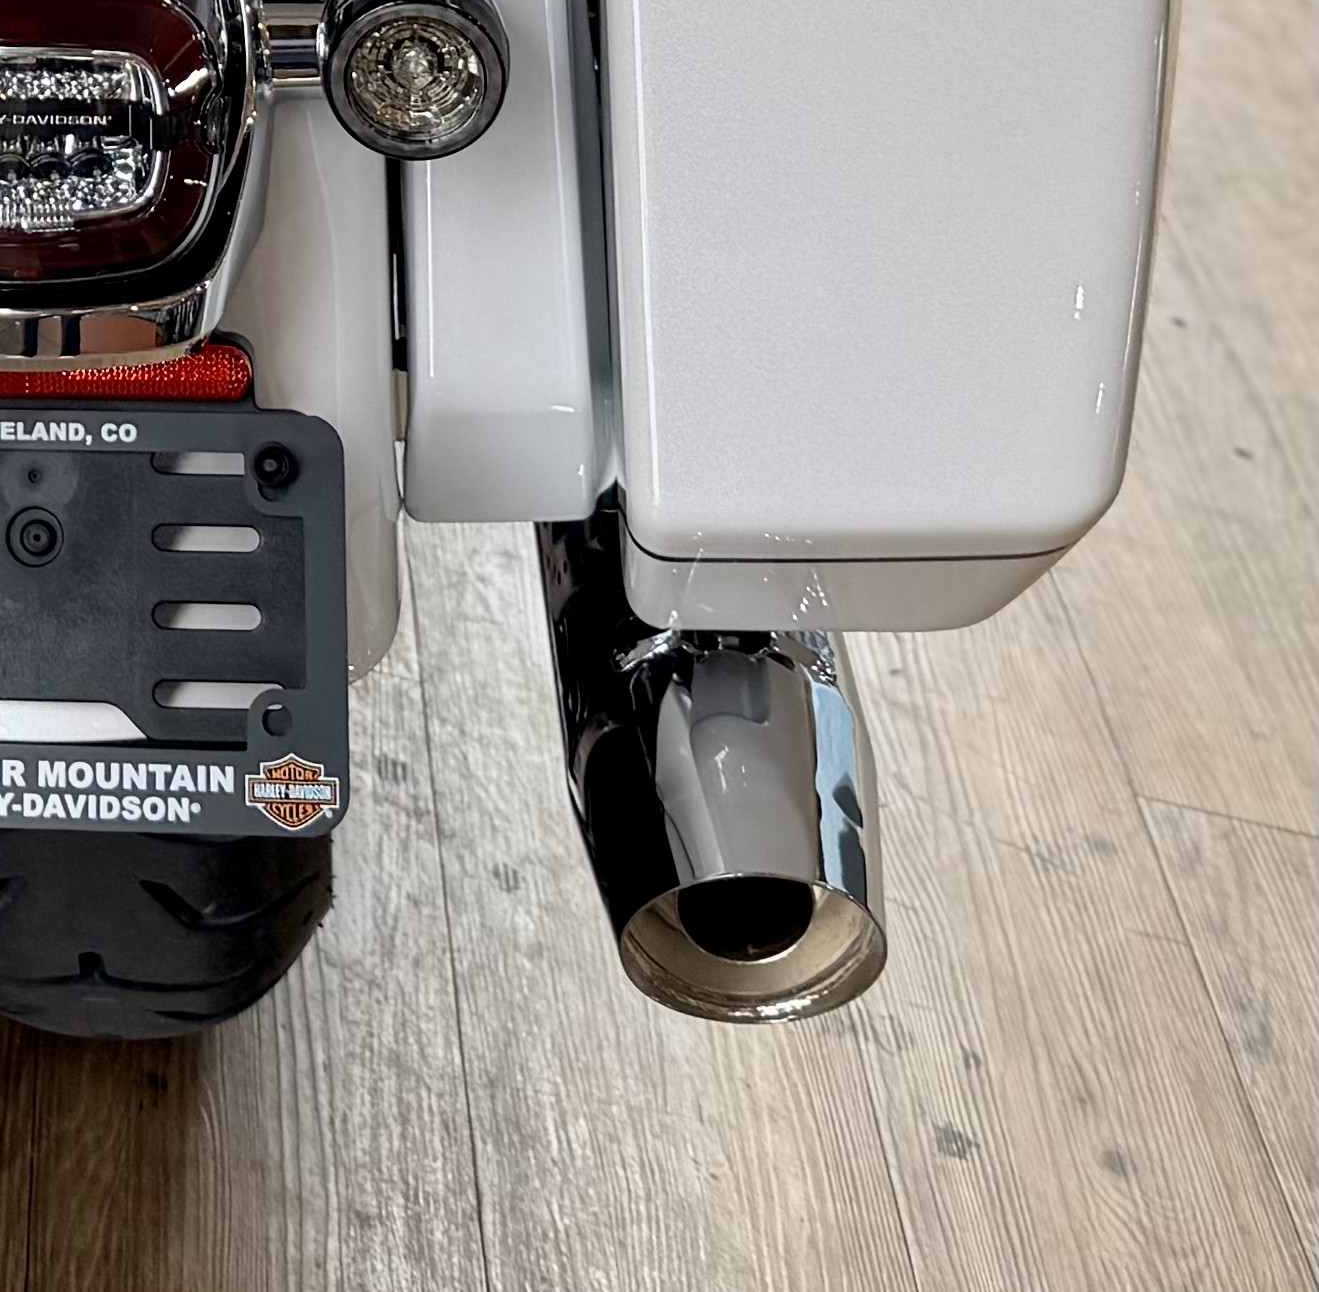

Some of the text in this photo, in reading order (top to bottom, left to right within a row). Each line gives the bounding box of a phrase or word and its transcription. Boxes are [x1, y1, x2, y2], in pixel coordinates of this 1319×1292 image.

[100, 422, 138, 443] CO
[37, 760, 235, 793] MOUNTAIN
[271, 763, 314, 781] MOTOR
